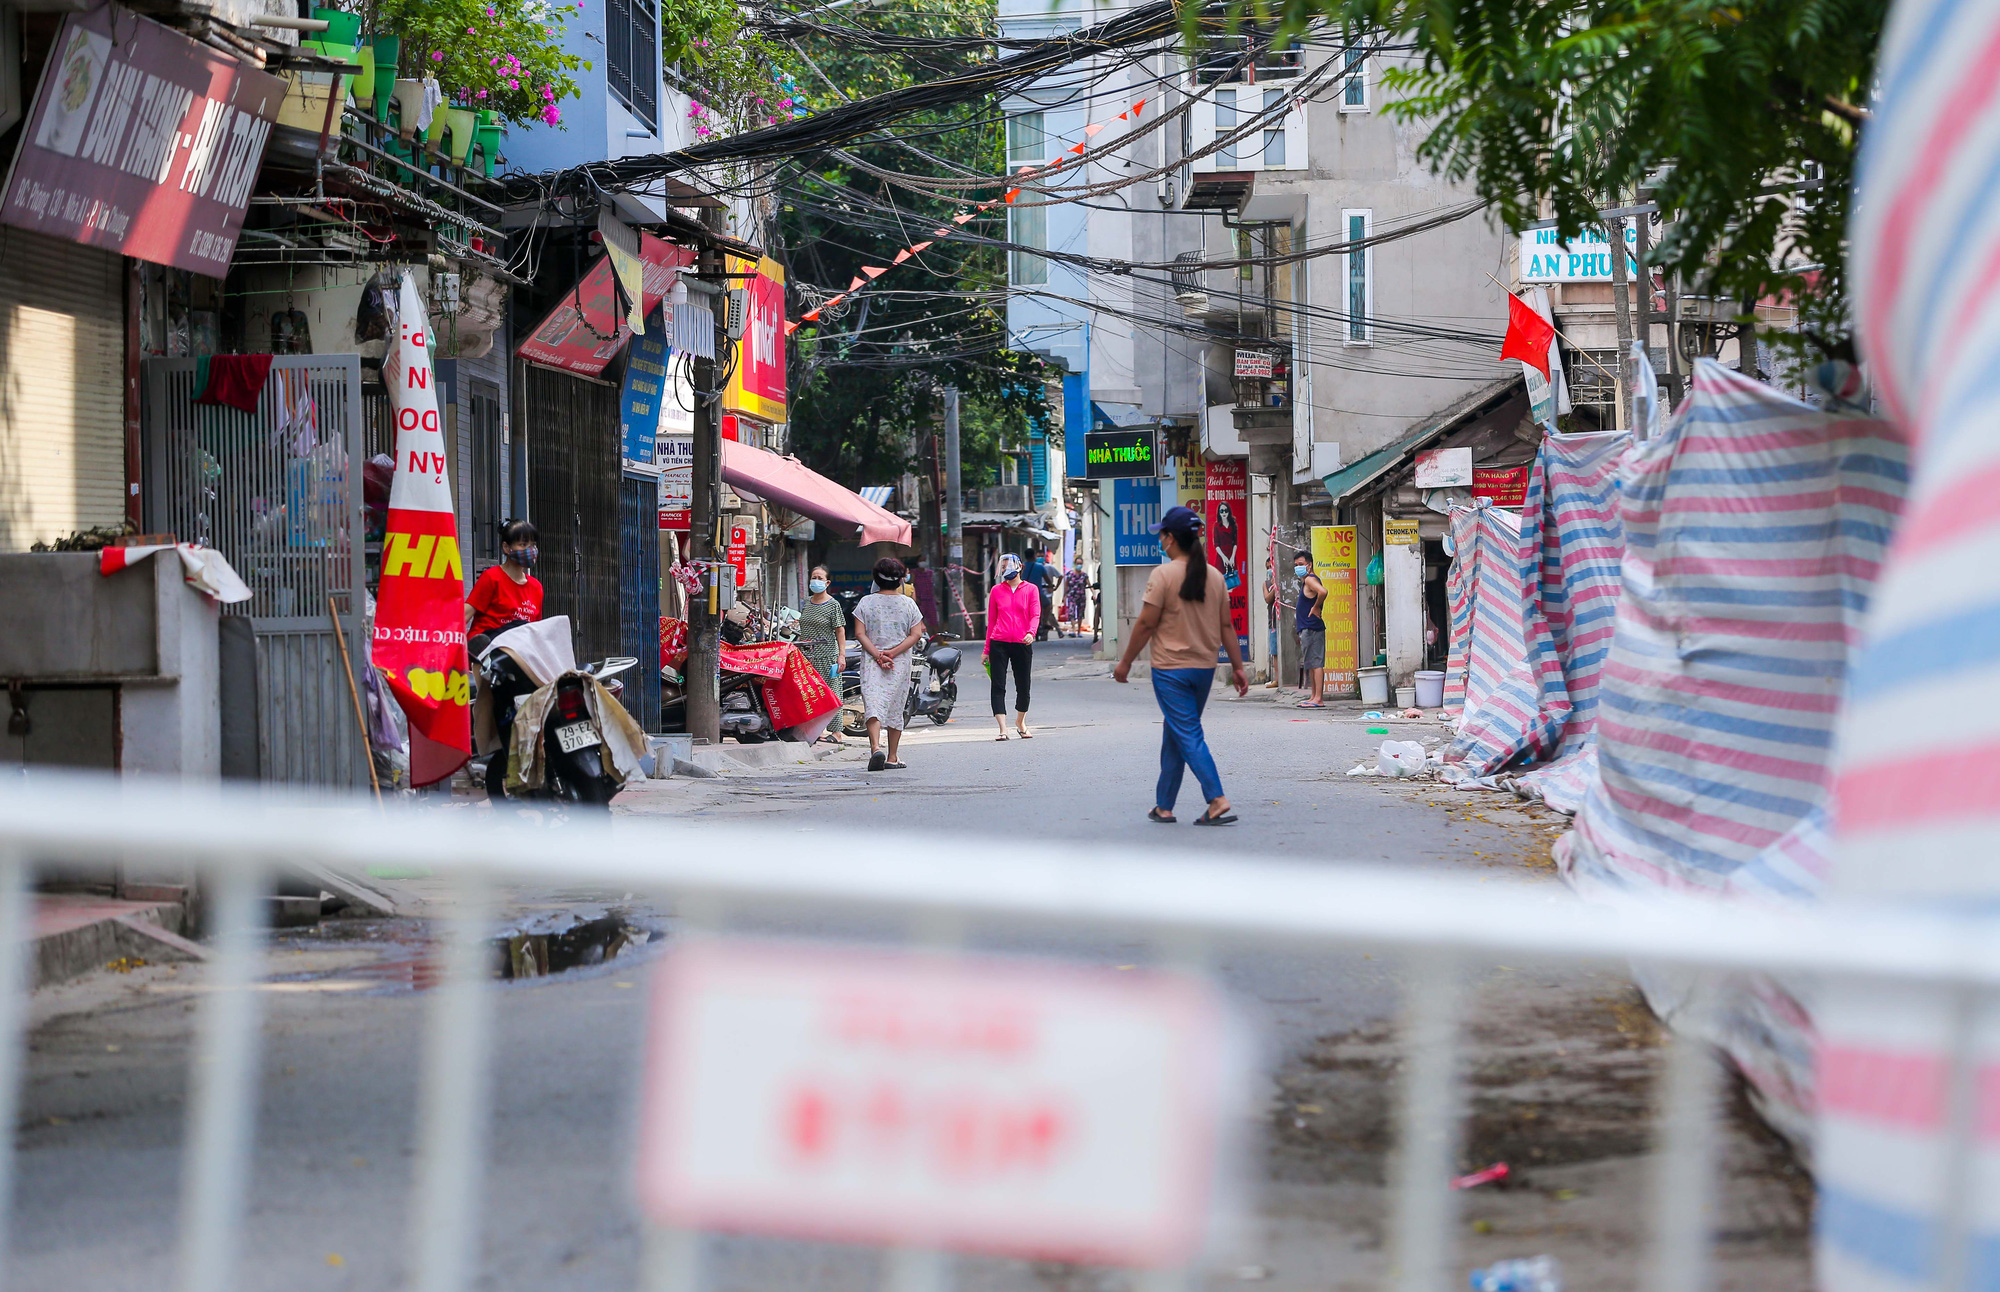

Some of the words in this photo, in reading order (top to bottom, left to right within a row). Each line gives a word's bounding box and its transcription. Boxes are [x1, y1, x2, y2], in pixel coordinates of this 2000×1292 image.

[120, 74, 194, 186] THANG
[1527, 254, 1561, 278] AN
[657, 439, 676, 455] NHÀ
[1088, 442, 1113, 464] NHÀ
[1112, 438, 1151, 462] THUỐC
[1212, 463, 1239, 474] Shop
[1119, 503, 1161, 535] THU
[1119, 545, 1130, 557] 99
[1131, 543, 1149, 557] VĂN
[1320, 569, 1350, 579] Chuyên
[1332, 581, 1353, 596] CÔNG
[1336, 598, 1350, 614] TÁC
[1333, 618, 1353, 633] CHỮA
[394, 625, 429, 645] TIỆC
[1336, 636, 1352, 652] MỚI
[1340, 653, 1354, 670] SỨC
[1328, 671, 1344, 682] VÀNG
[562, 721, 592, 738] 29-E2
[563, 731, 600, 750] 370.51
